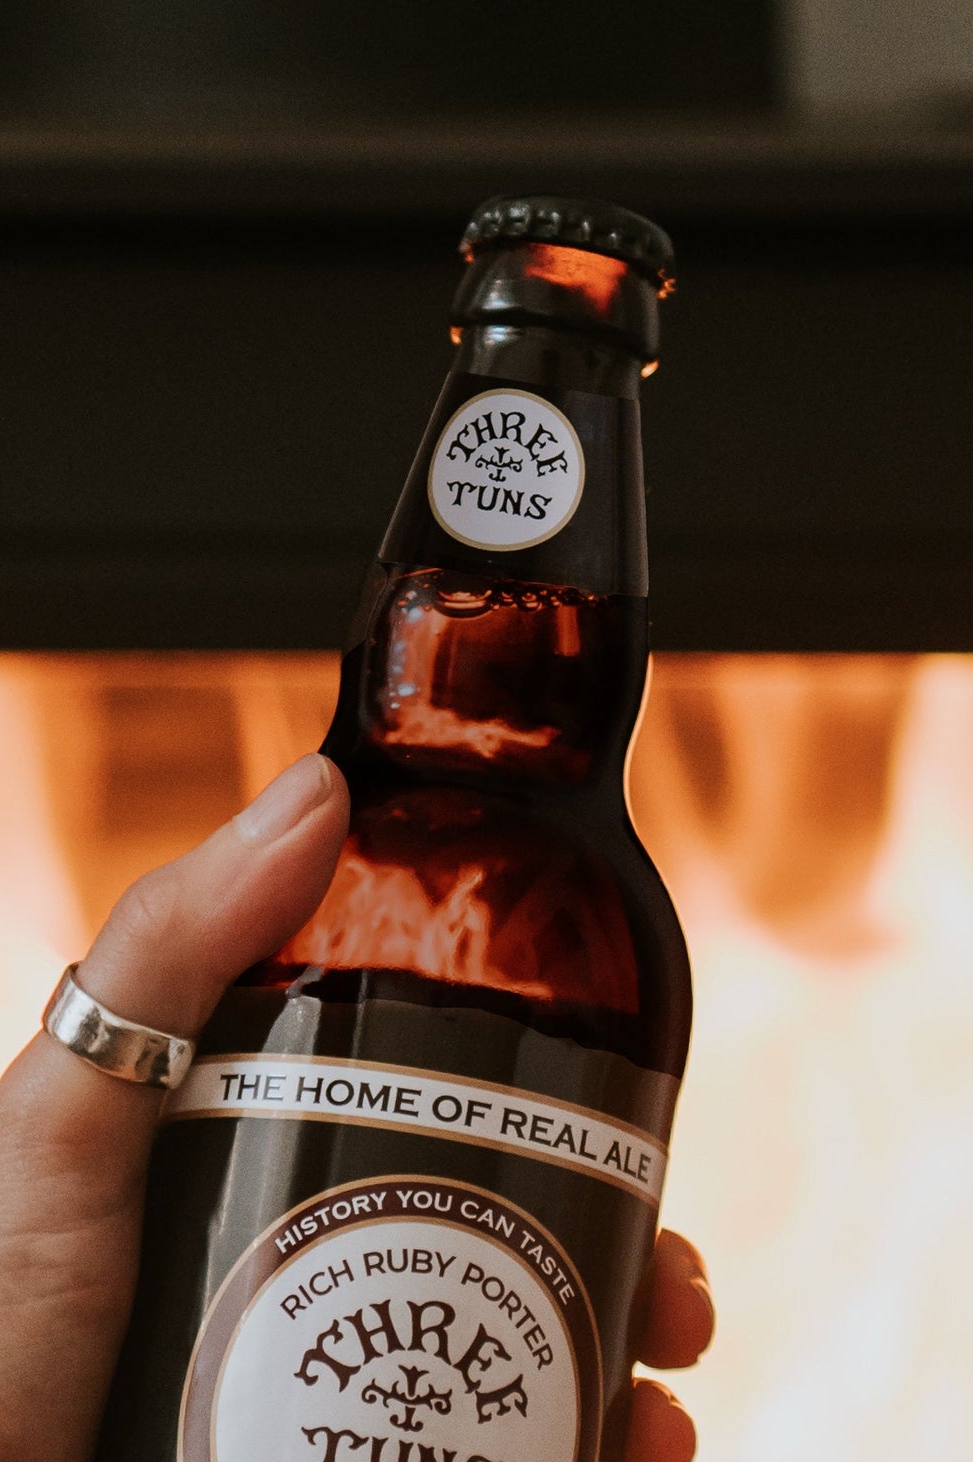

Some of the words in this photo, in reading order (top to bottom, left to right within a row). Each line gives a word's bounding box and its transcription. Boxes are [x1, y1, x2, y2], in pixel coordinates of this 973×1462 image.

[446, 411, 568, 477] THREE
[446, 481, 553, 520] TUNS
[219, 1072, 287, 1101] THE
[295, 1075, 422, 1117] HOME
[431, 1094, 492, 1128] OF
[499, 1107, 597, 1161] REAL
[603, 1140, 652, 1184] ALE
[274, 1190, 387, 1254] HISTORY
[396, 1189, 453, 1213] YOU
[460, 1200, 515, 1238] CAN
[519, 1229, 575, 1306] TASTE
[279, 1258, 355, 1321] RICH
[363, 1248, 457, 1278] RUBY
[461, 1262, 554, 1370] PORTER
[293, 1299, 528, 1424] THREE
